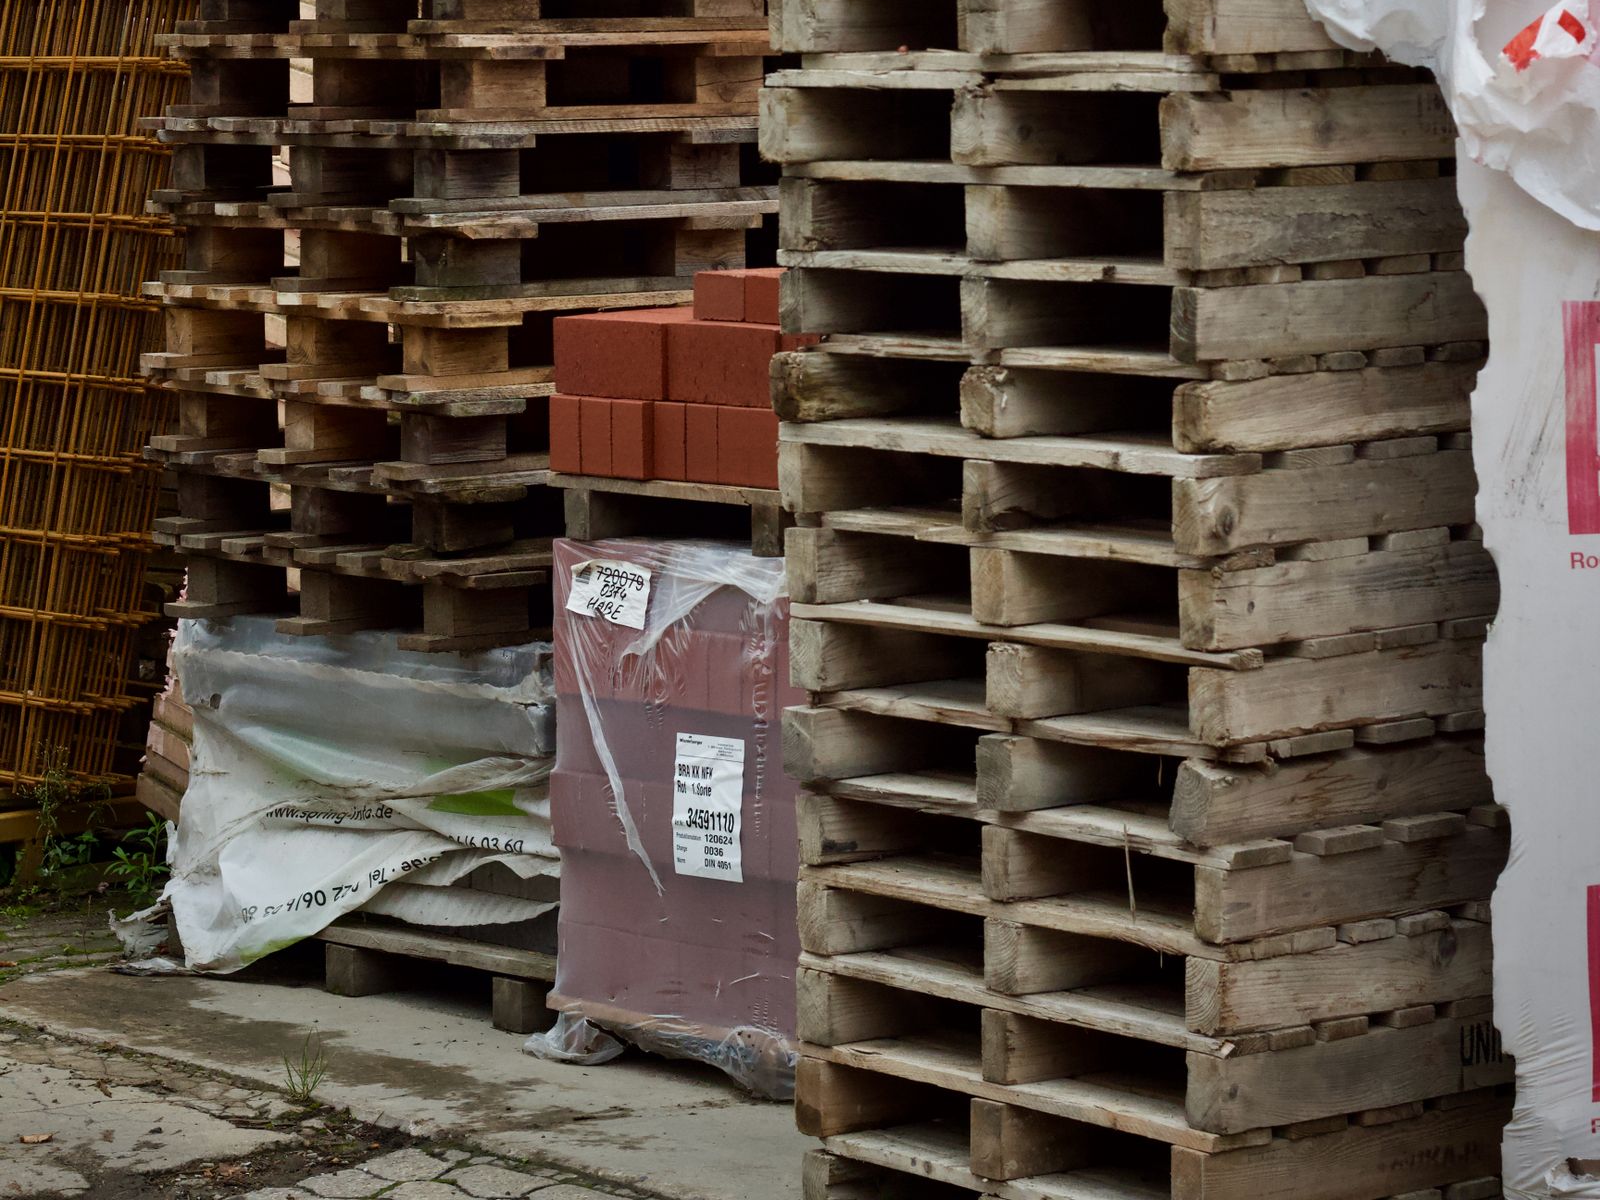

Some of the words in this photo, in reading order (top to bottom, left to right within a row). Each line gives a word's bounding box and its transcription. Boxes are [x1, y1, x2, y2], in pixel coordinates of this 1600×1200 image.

[596, 565, 644, 591] 720079
[600, 583, 627, 600] 0374
[686, 808, 734, 833] 34591110
[705, 834, 733, 845] 120624
[704, 846, 723, 857] 0036
[704, 858, 715, 868] DIN
[717, 860, 731, 870] 4051
